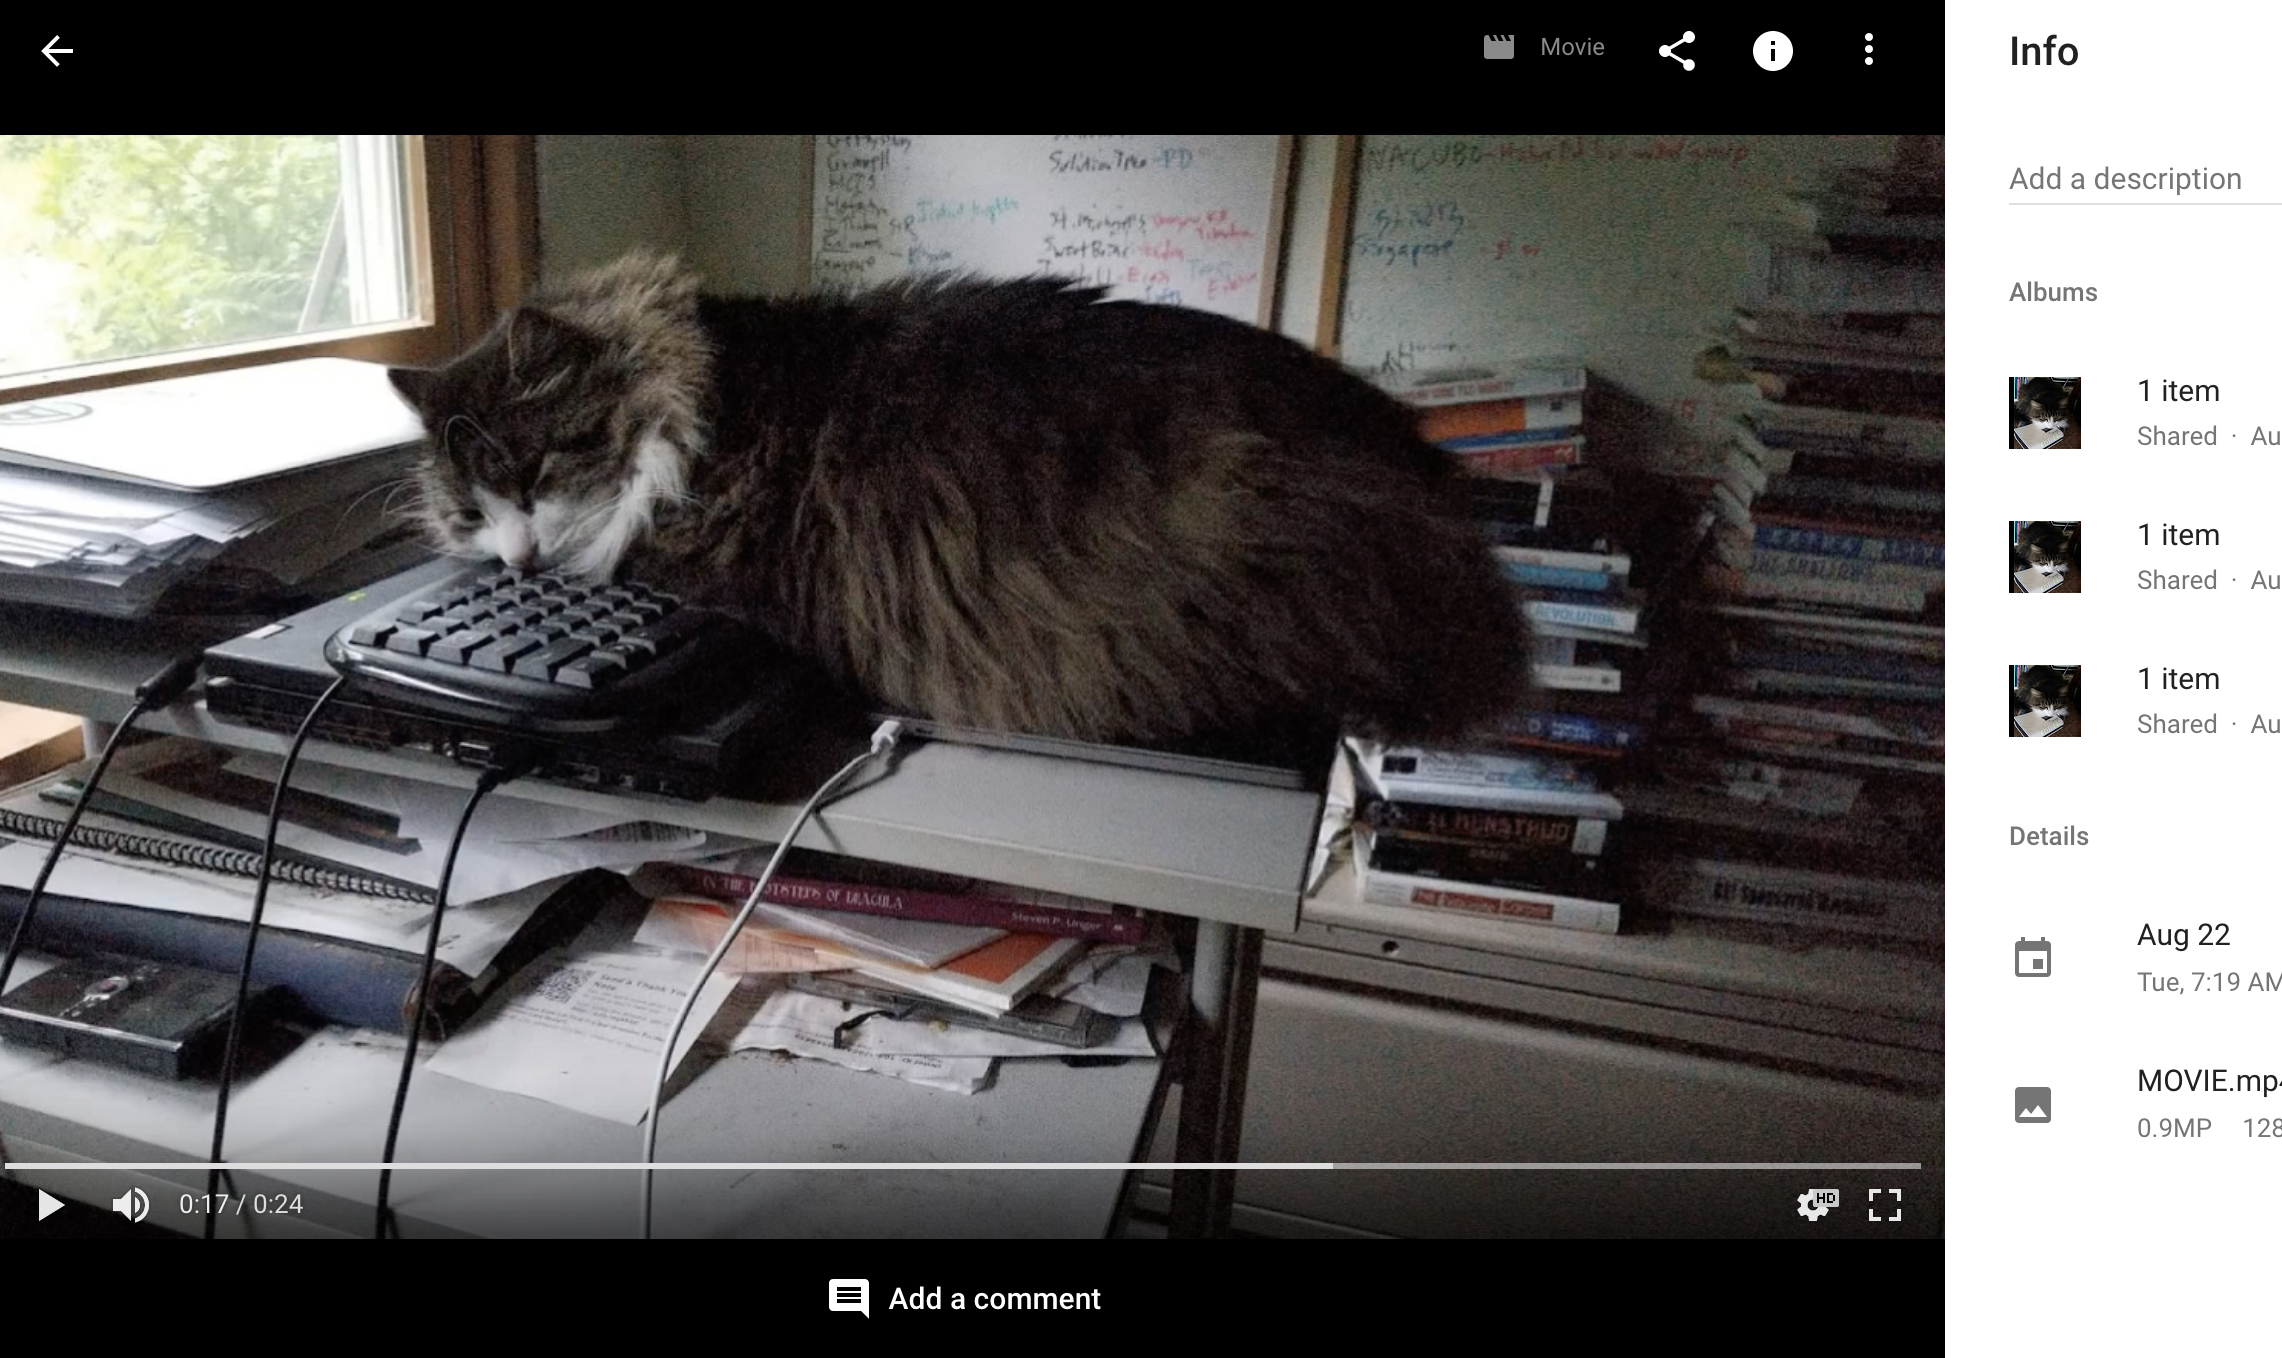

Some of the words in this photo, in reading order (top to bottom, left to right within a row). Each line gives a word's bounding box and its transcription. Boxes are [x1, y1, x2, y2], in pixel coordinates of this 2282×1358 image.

[1541, 37, 1605, 56] Movie
[2011, 33, 2079, 67] Info
[2008, 165, 2061, 190] Add
[2070, 172, 2086, 190] a
[2094, 165, 2242, 196] description
[2008, 280, 2098, 302] Albums
[2138, 378, 2149, 402] 1
[2162, 378, 2220, 403] item
[2137, 425, 2217, 446] Shared
[2250, 426, 2281, 446] Au
[2138, 522, 2149, 546] 1
[2162, 522, 2220, 547] item
[2137, 569, 2217, 590] Shared
[2250, 570, 2281, 590] Au
[2138, 666, 2149, 690] 1
[2162, 666, 2220, 691] item
[2137, 713, 2217, 734] Shared
[2250, 714, 2281, 734] Au
[2010, 824, 2089, 846] Details
[2136, 922, 2189, 952] Aug
[2197, 922, 2231, 946] 22
[2136, 971, 2185, 996] Tue,
[2191, 971, 2241, 992] 7:19
[2247, 971, 2282, 992] AM
[2138, 1068, 2282, 1098] MOVIE.mp
[2137, 1117, 2212, 1138] 0.9MP
[2243, 1117, 2282, 1138] 128
[179, 1193, 229, 1214] 0:17
[253, 1193, 304, 1214] 0:24
[1816, 1192, 1836, 1204] HD
[888, 1285, 942, 1311] Add
[950, 1292, 966, 1311] a
[973, 1288, 1102, 1311] comment
